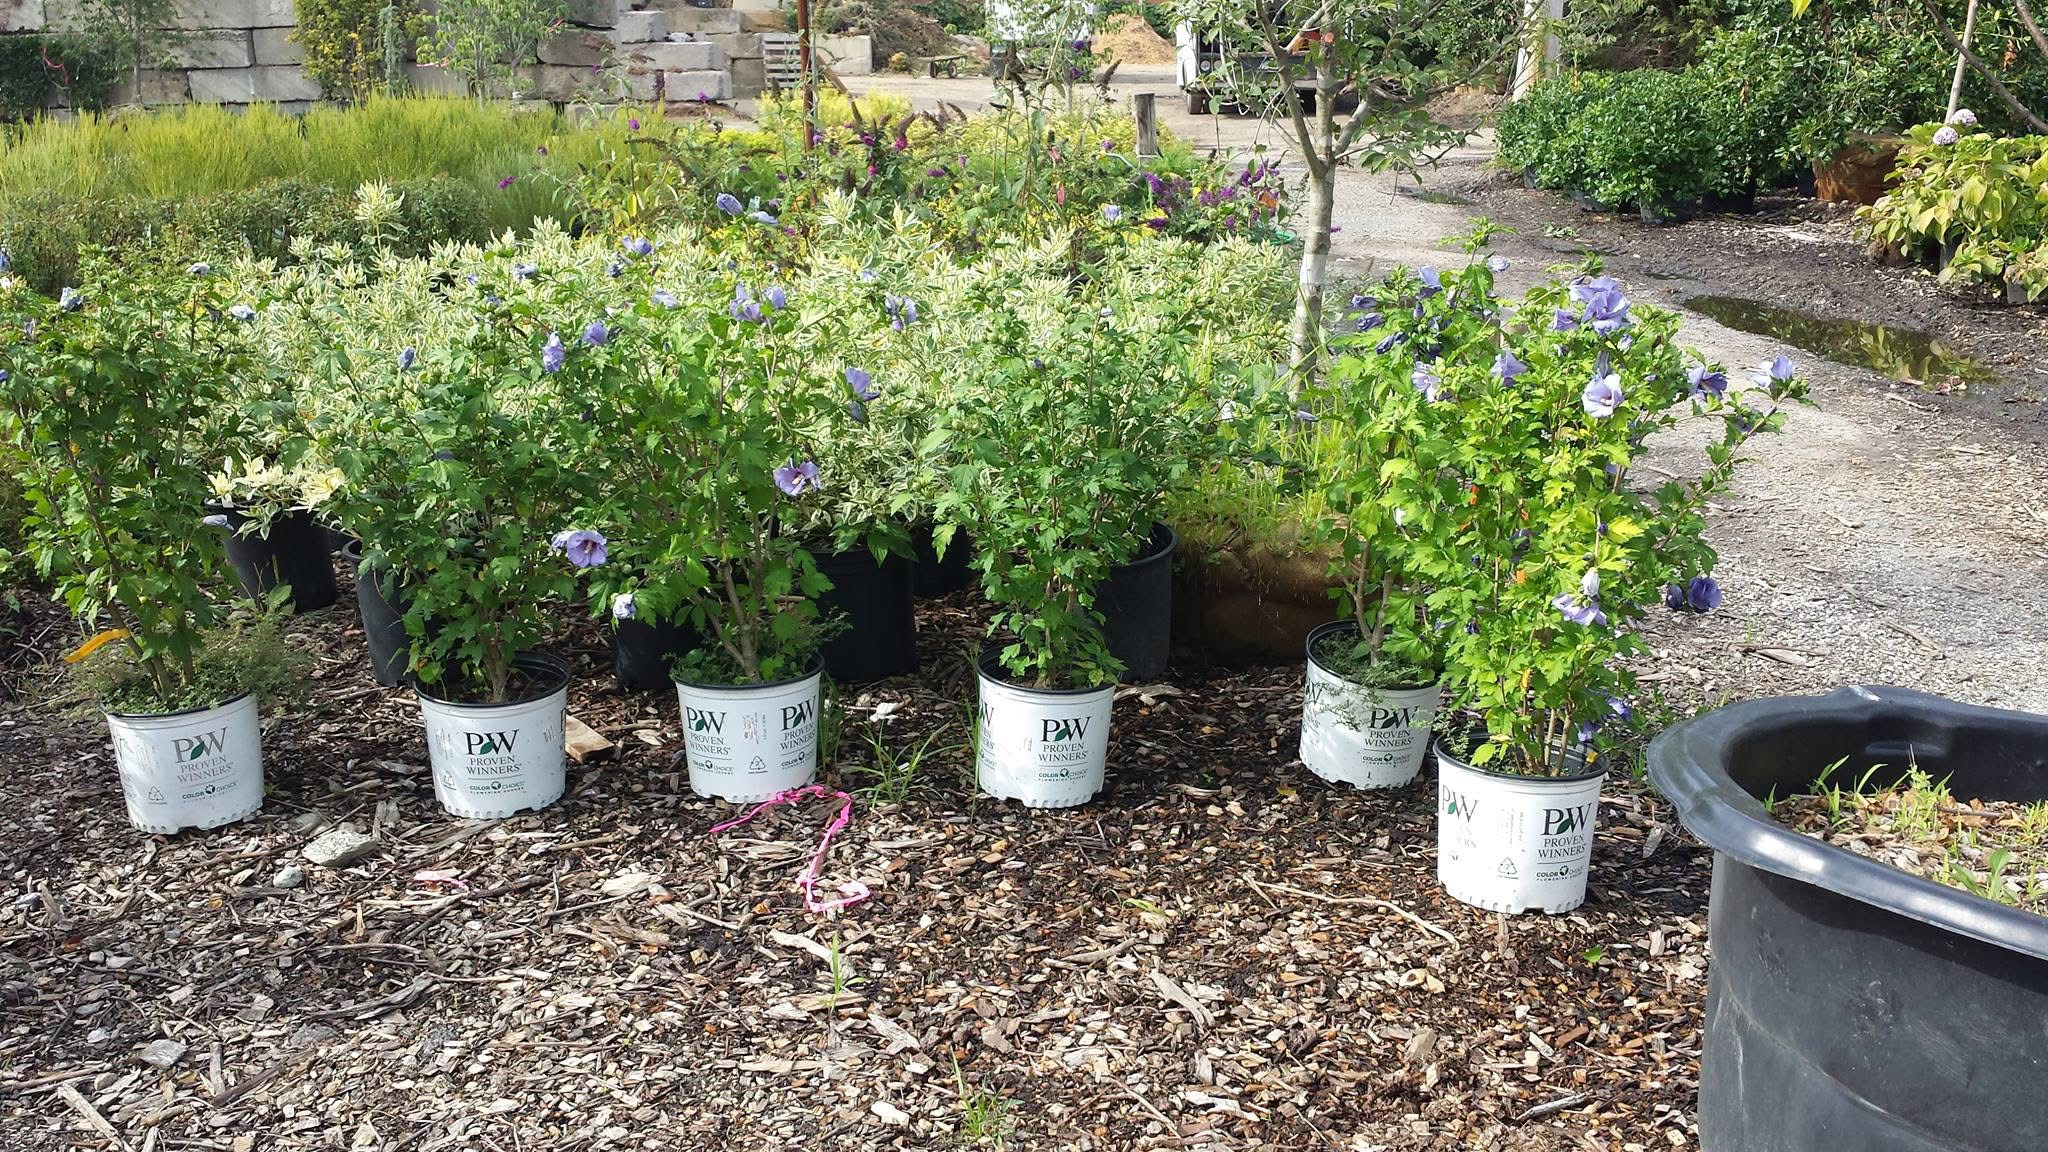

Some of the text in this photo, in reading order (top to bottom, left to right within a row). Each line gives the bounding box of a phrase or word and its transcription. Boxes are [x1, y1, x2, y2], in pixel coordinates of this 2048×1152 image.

[784, 722, 814, 741] PROVEN
[1370, 730, 1410, 739] PROVEN
[690, 732, 724, 745] PROVEN
[1364, 737, 1413, 748] WINNERS
[689, 740, 730, 755] WINNERS
[1043, 742, 1084, 753] PROVEN
[470, 756, 515, 766] PROVEN
[1038, 751, 1087, 762] WINNERS
[180, 755, 227, 773] PROVEN
[466, 764, 521, 775] WINNERS
[177, 763, 233, 783] WINNERS
[1543, 834, 1585, 847] PROVEN
[1537, 845, 1586, 859] WINNERS
